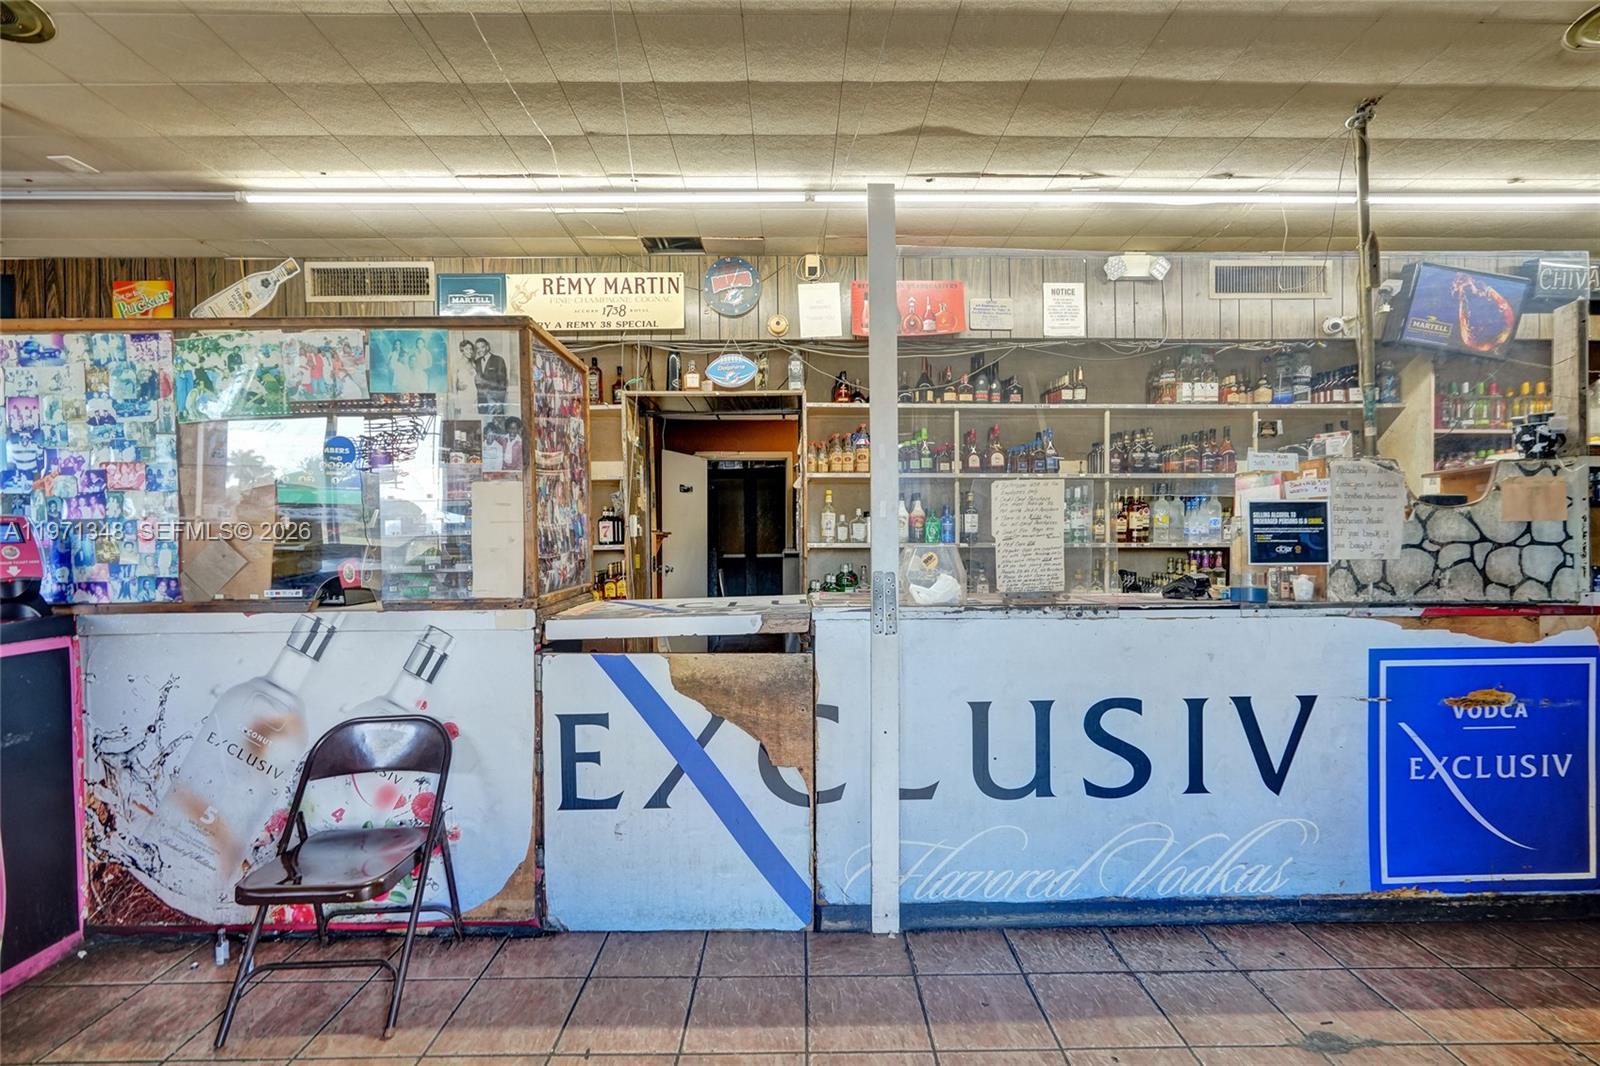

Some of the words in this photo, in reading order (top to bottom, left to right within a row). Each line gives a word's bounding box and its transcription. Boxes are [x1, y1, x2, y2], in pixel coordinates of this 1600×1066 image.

[542, 275, 601, 295] RÉMY
[604, 276, 681, 294] MARTIN
[1051, 288, 1076, 296] NOTICE
[574, 296, 632, 304] CHAMPAGNE
[634, 295, 673, 303] COGNAC
[602, 304, 627, 317] 1738
[616, 320, 659, 328] SPECIAL
[1412, 319, 1449, 333] MARTELL
[553, 693, 1319, 812] EXCUSIV
[1408, 752, 1573, 781] EXCLUSIV
[199, 806, 219, 825] 5
[1100, 818, 1320, 898] Vodkas
